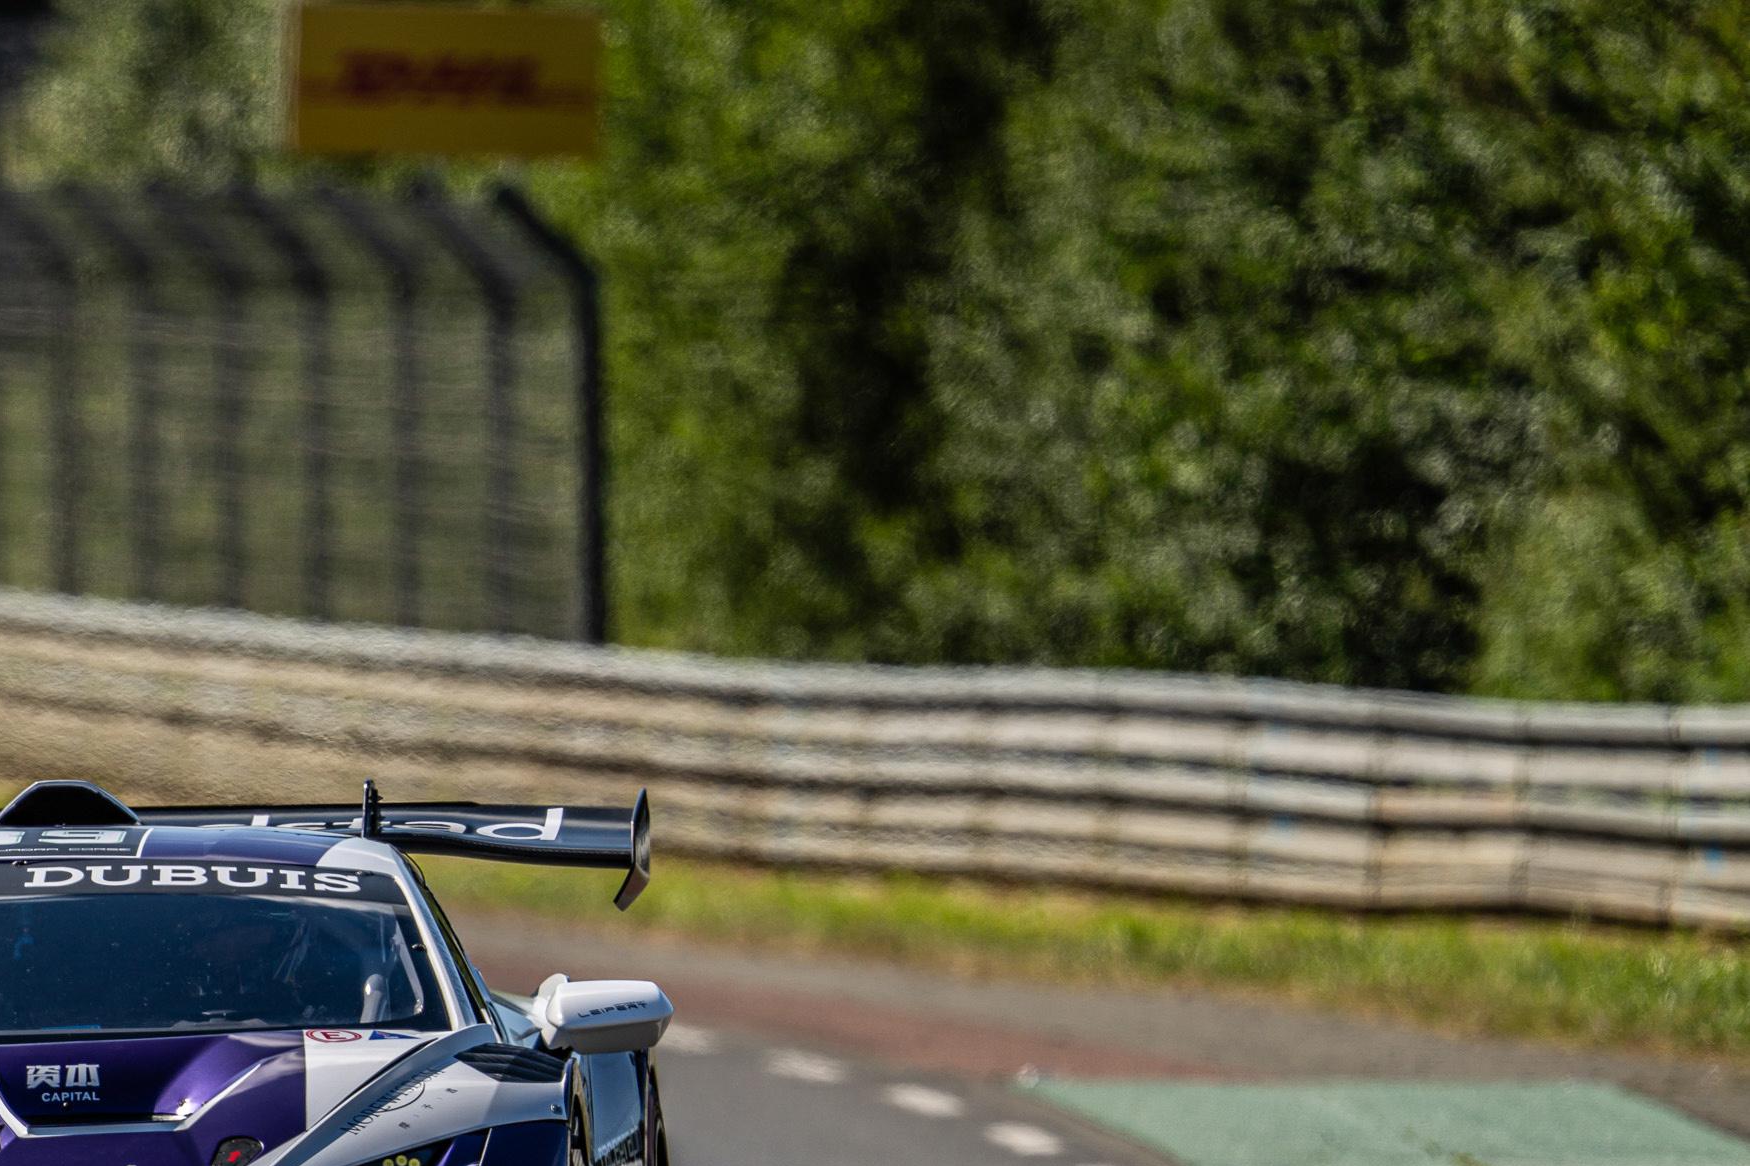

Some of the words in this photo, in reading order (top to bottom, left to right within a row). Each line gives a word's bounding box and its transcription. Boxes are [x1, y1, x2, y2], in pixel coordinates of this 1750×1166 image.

[24, 865, 362, 893] DUBUIS
[25, 1063, 101, 1089] 资本
[41, 1091, 101, 1103] CAPITAL
